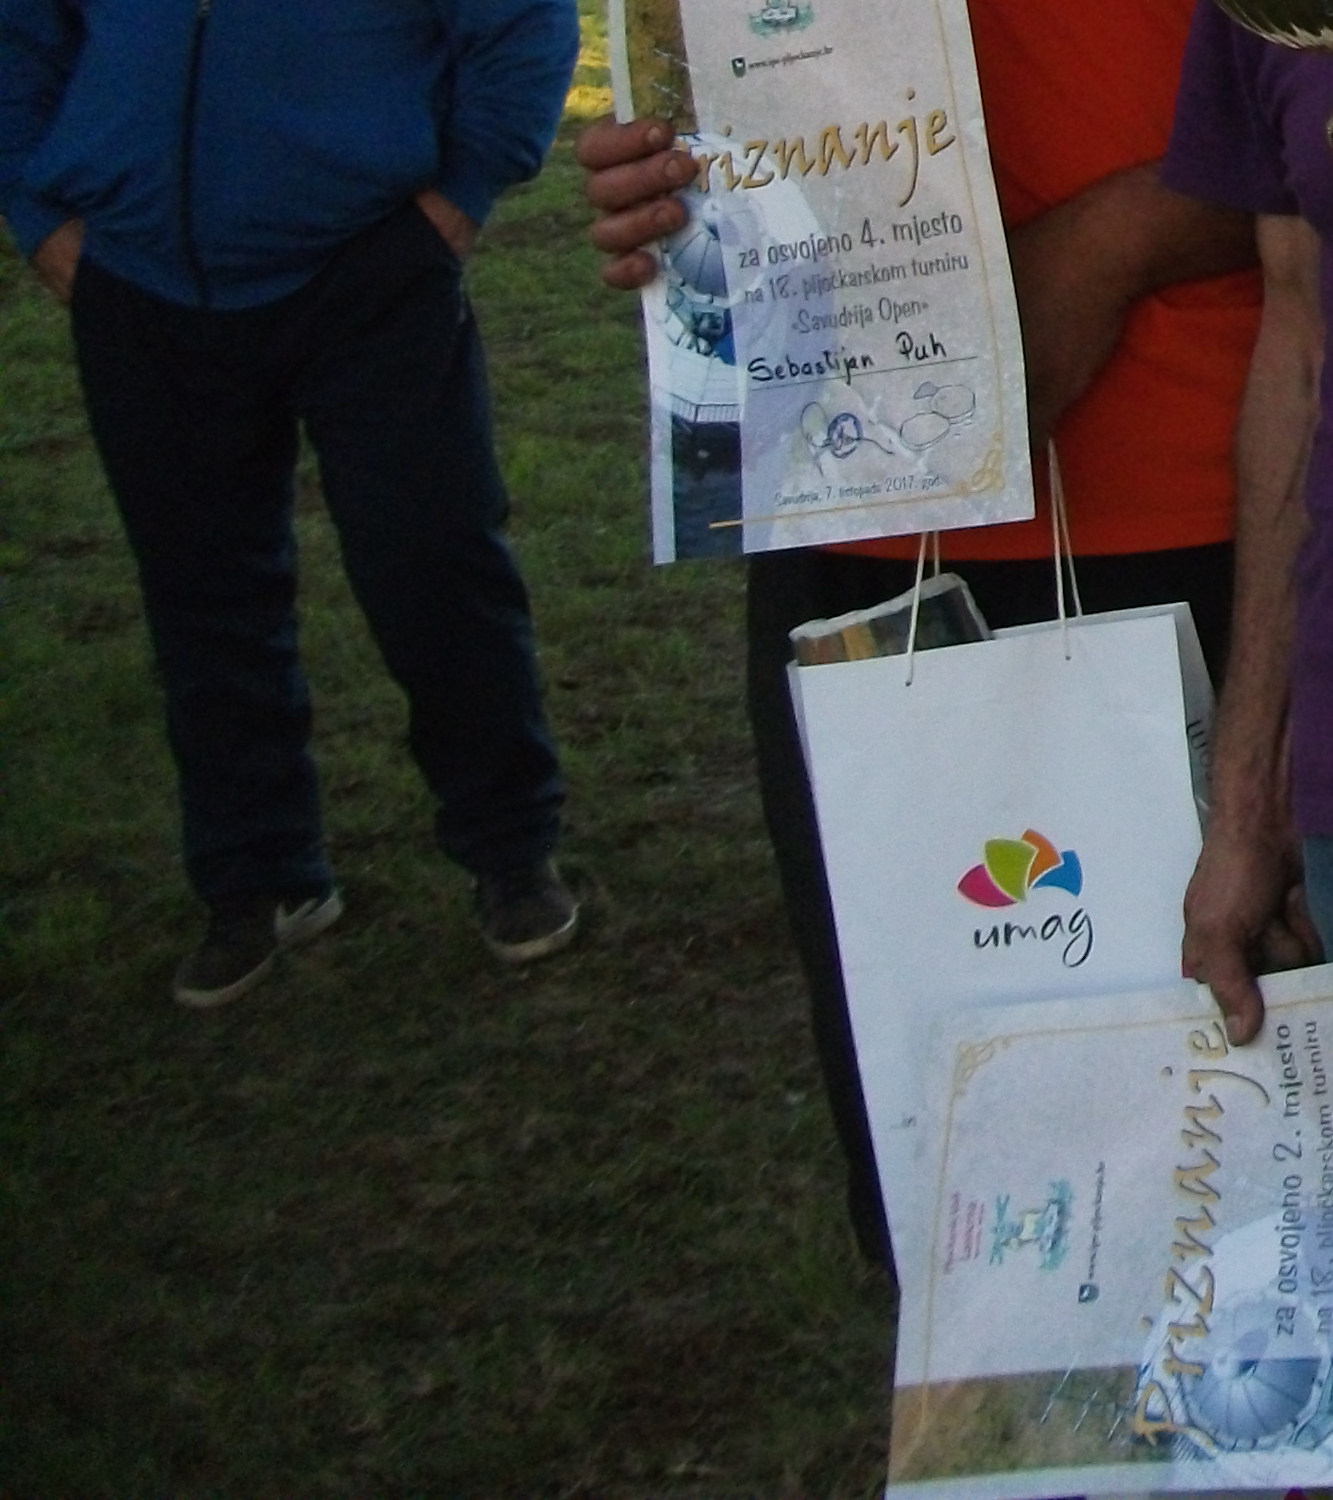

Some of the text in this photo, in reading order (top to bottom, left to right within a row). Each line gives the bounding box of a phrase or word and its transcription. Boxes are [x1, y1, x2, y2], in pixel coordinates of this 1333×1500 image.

[675, 87, 956, 208] riznanje
[738, 211, 964, 269] za osvojeno 4. mjesto
[744, 286, 764, 303] na
[911, 252, 970, 277] turniru
[895, 331, 948, 362] Puh
[973, 907, 1094, 968] umag
[1305, 1020, 1328, 1096] turniru
[1272, 1024, 1307, 1338] za osvojeno 2. mjesto
